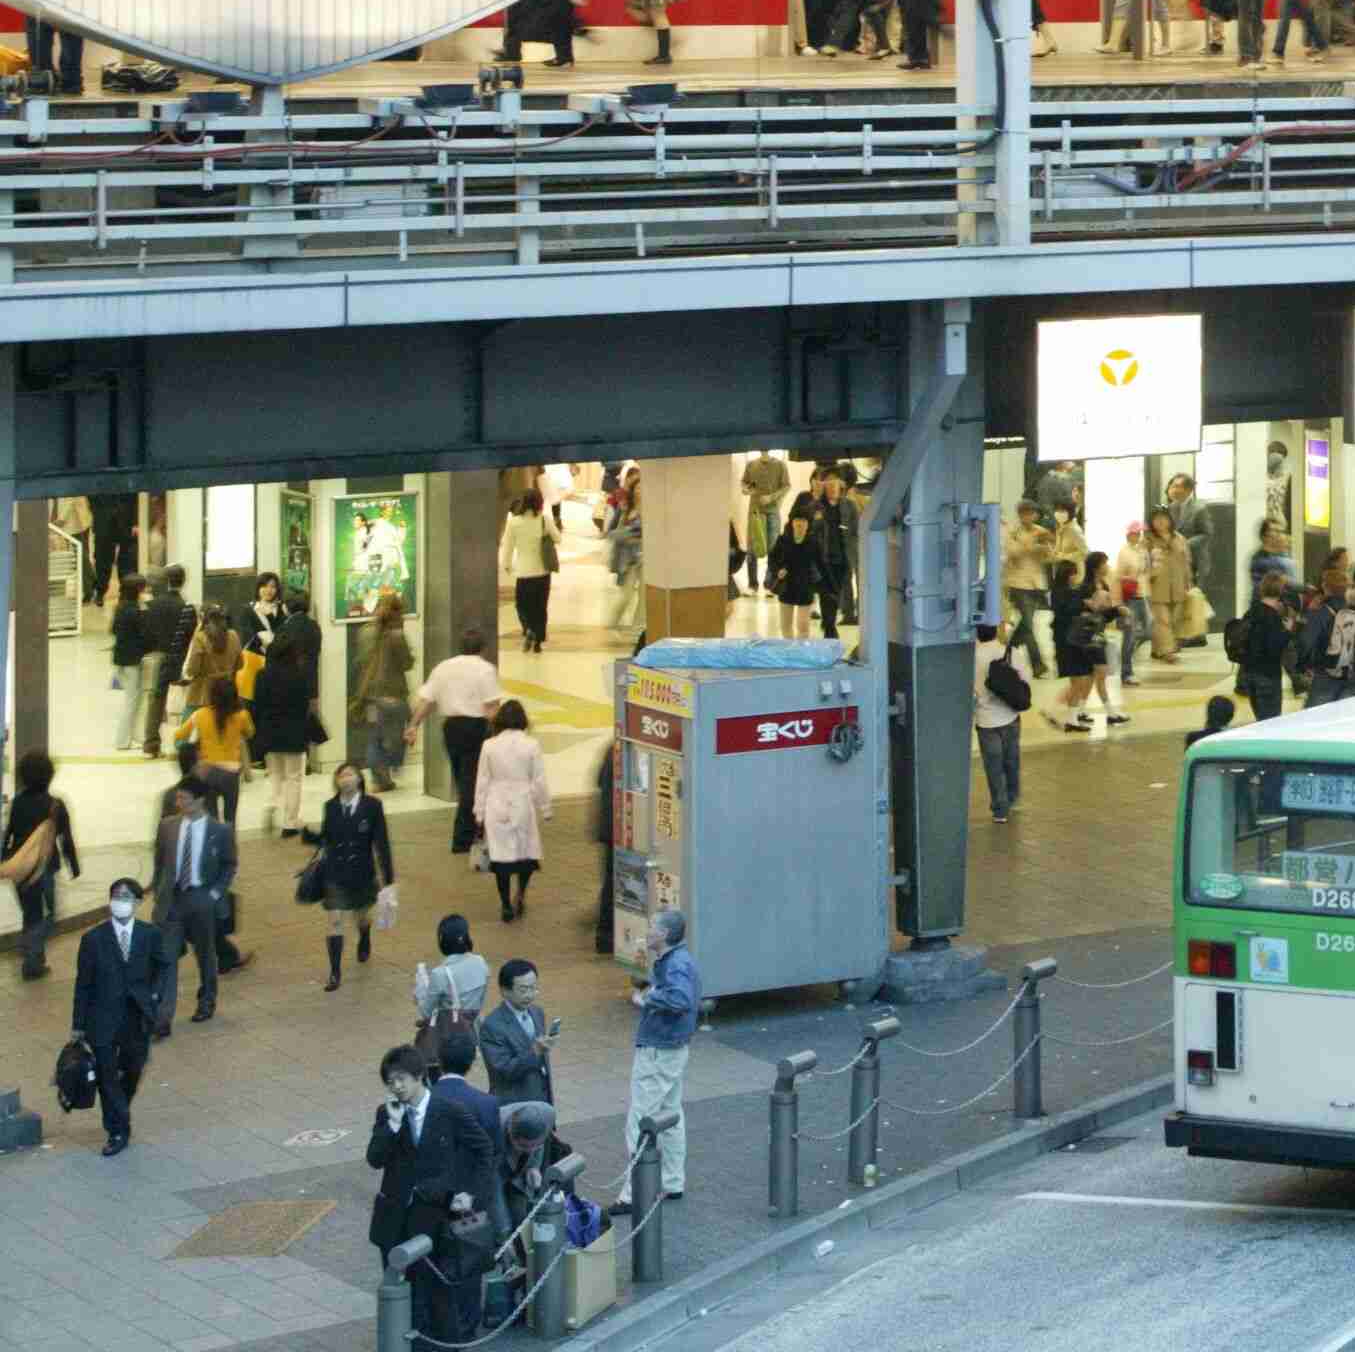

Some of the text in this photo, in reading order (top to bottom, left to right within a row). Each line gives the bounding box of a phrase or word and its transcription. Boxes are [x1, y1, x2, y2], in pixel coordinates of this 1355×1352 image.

[641, 715, 669, 739] 宝くじ
[756, 719, 813, 743] 宝くじ
